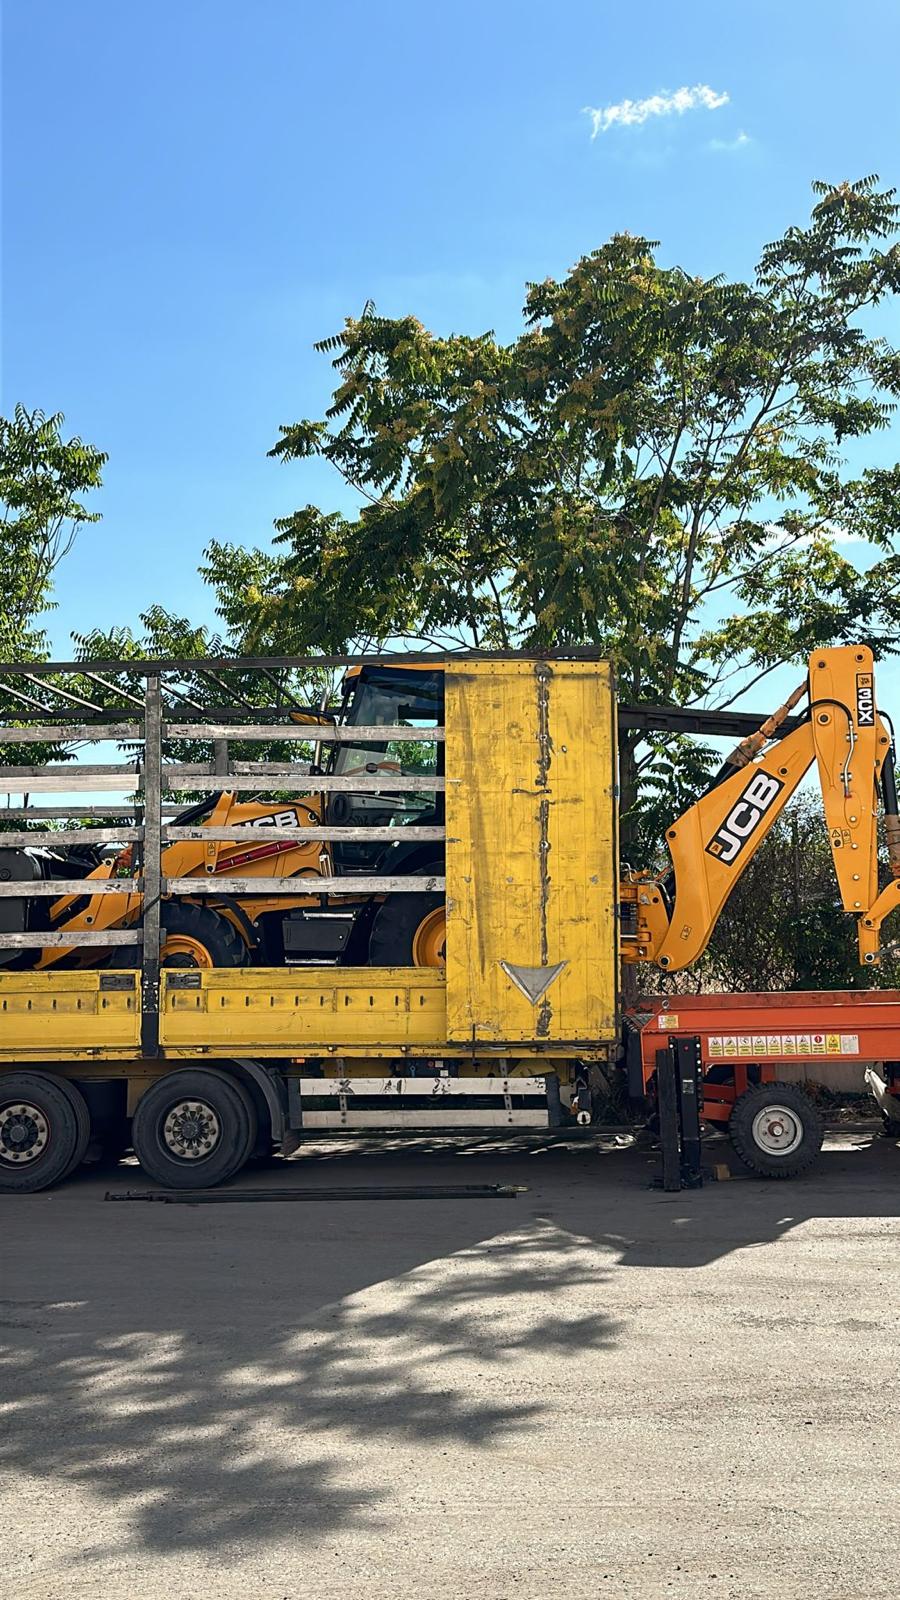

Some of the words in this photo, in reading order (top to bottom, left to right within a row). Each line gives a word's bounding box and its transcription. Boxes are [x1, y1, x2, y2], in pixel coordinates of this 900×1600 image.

[858, 688, 874, 722] 3CX
[236, 811, 298, 827] CB
[718, 774, 780, 861] JCB
